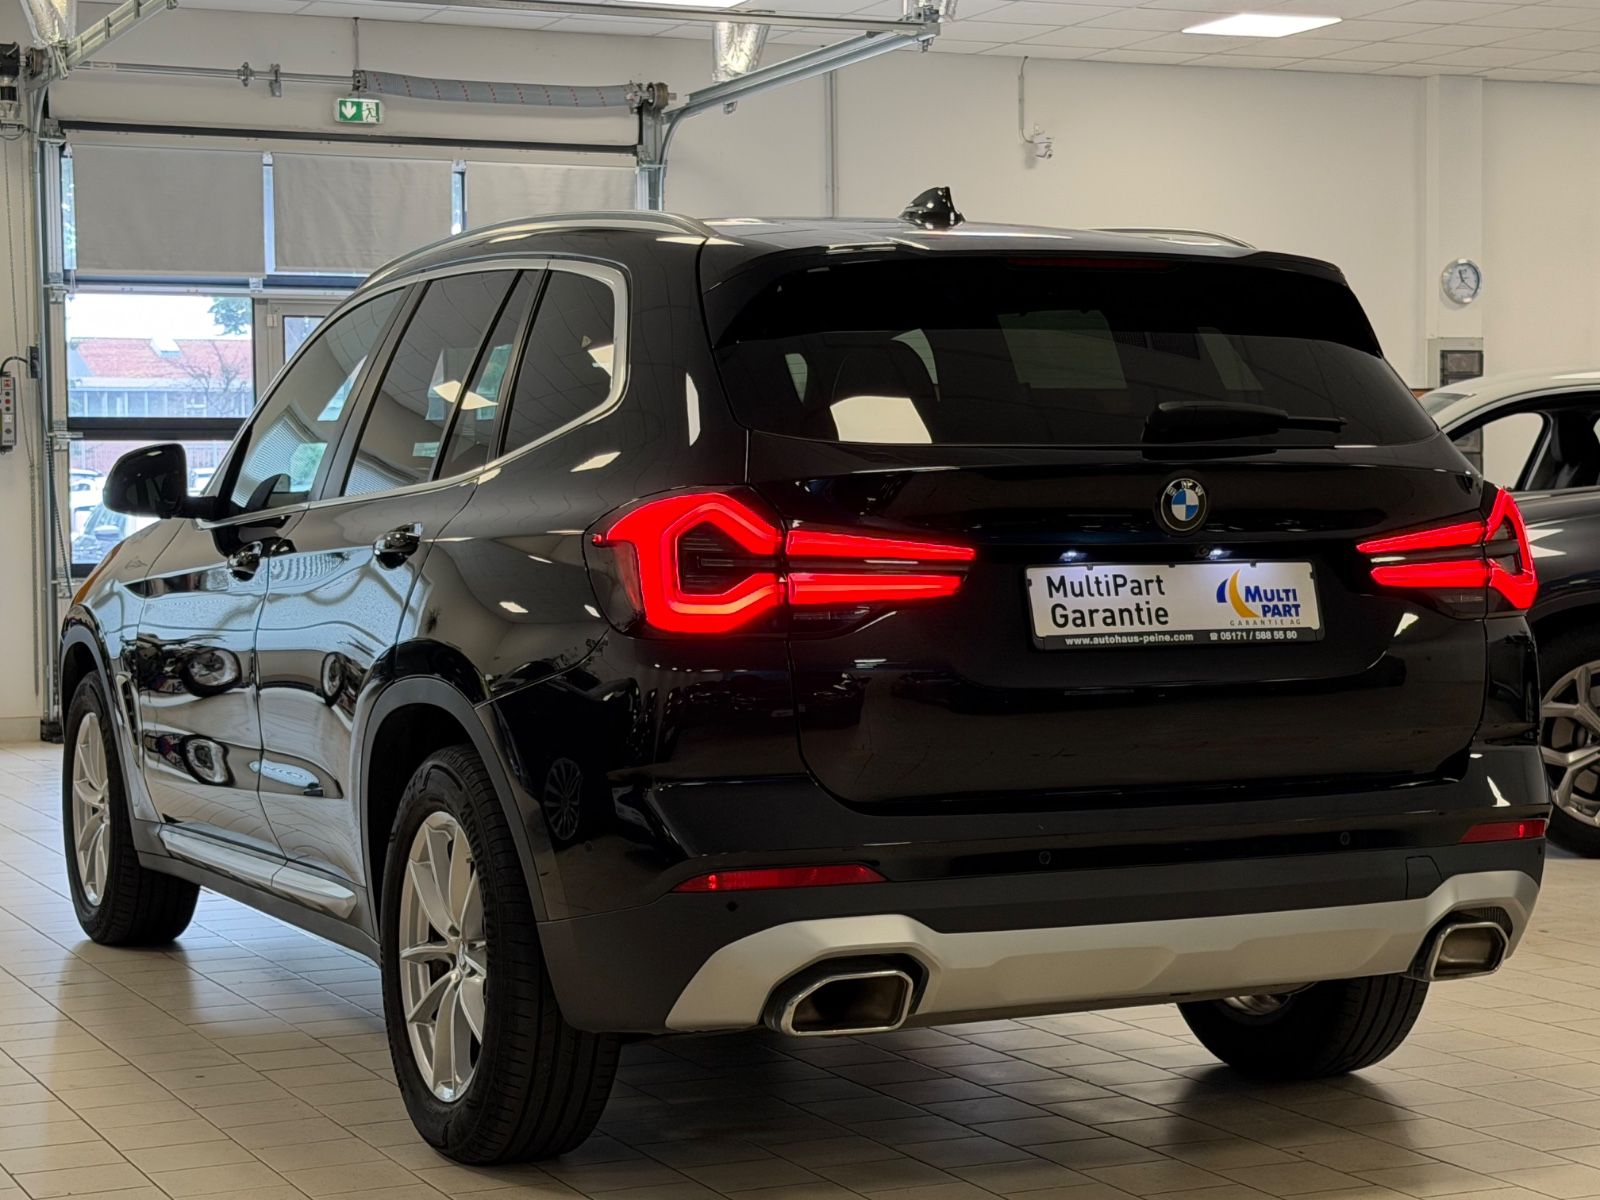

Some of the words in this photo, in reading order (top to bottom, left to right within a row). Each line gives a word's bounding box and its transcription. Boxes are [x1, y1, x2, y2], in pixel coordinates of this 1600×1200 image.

[1167, 480, 1203, 496] BMW
[1046, 574, 1166, 599] MultiPart
[1244, 585, 1298, 603] MULTI
[1050, 601, 1169, 628] Garantie
[1261, 603, 1301, 618] PART
[1229, 618, 1284, 627] GARANTIE
[1289, 618, 1301, 626] AG
[1065, 633, 1194, 646] www.autohaus-peine.com
[1219, 631, 1247, 641] 05171
[1255, 631, 1272, 640] 588
[1273, 630, 1284, 640] 55
[1286, 630, 1298, 639] 80
